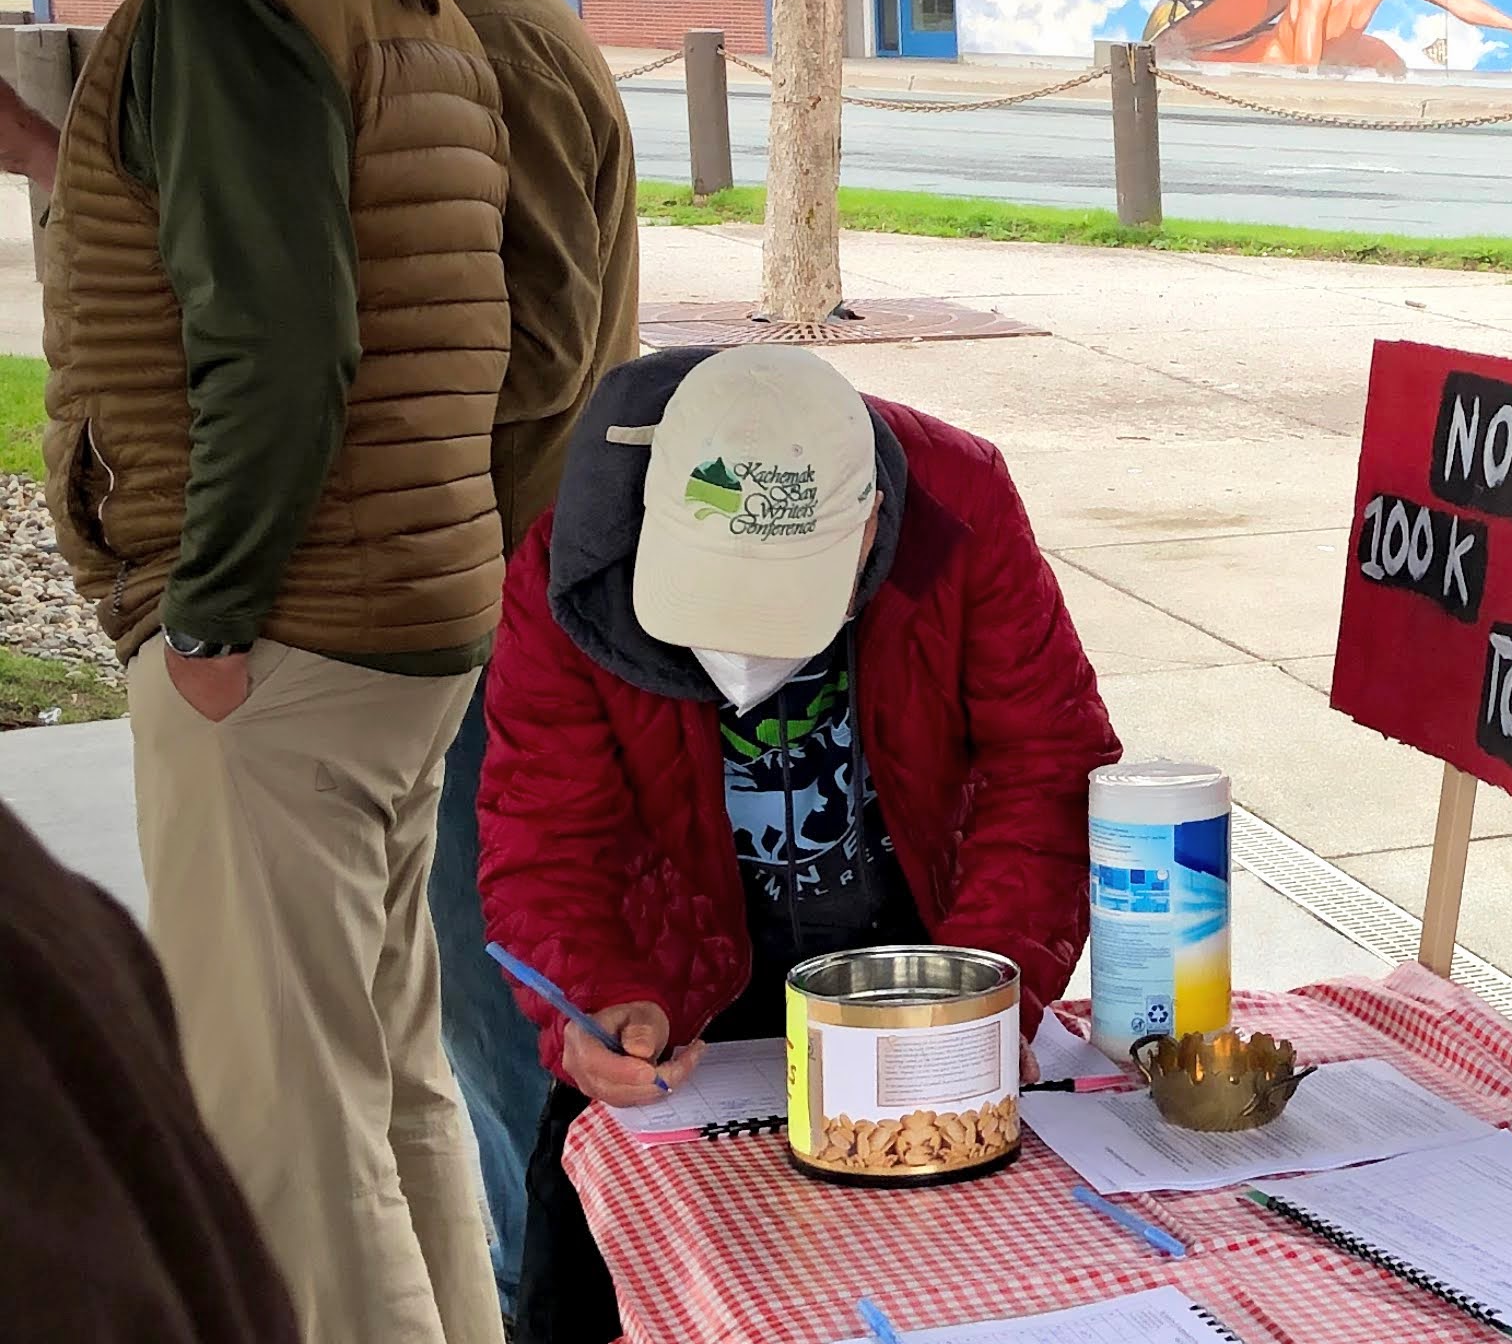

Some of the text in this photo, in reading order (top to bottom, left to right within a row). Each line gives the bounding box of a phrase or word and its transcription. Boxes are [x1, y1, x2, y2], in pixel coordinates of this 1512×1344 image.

[733, 461, 816, 490] Kachemak
[769, 484, 818, 503] Bay
[730, 513, 818, 541] Conference
